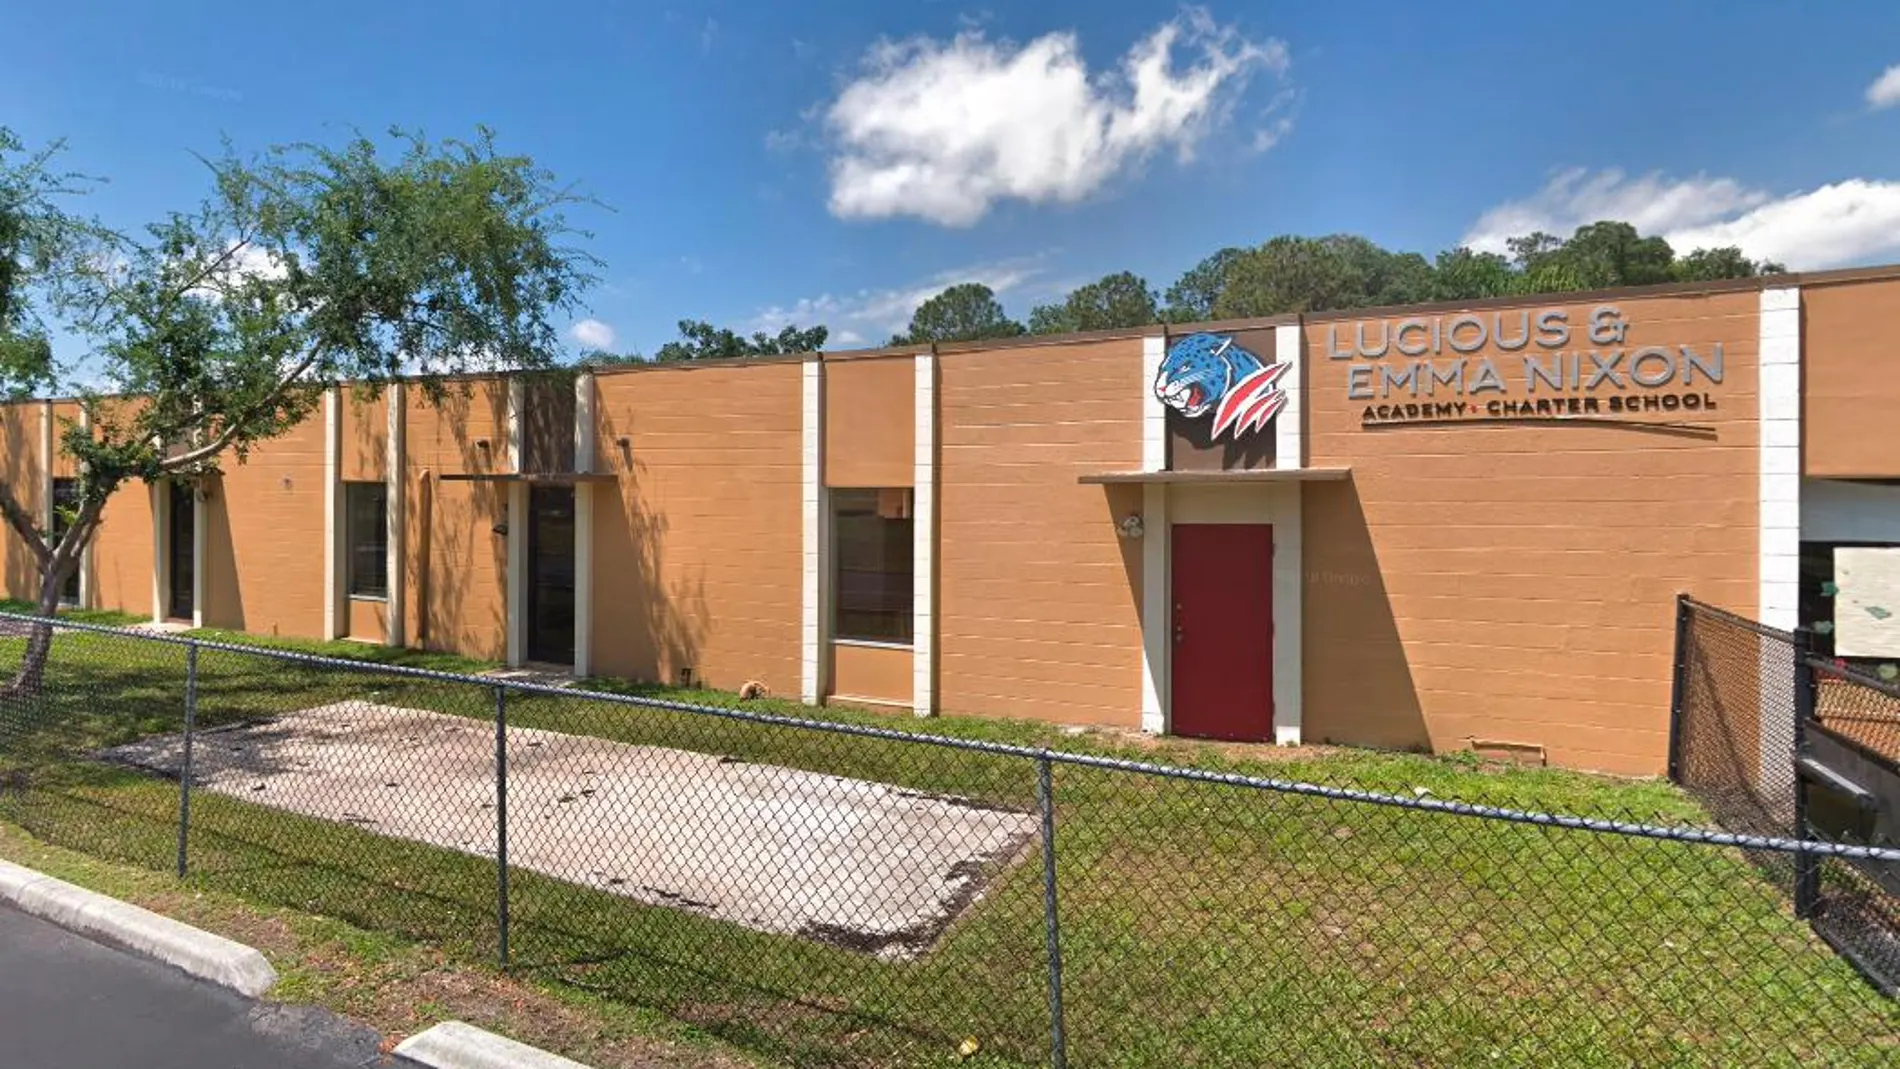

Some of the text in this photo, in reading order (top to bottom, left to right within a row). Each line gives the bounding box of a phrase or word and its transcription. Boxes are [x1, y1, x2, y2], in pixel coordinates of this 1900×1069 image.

[1328, 305, 1629, 359] LUCIOUS &
[1348, 341, 1724, 399] EMMA NIXON
[1362, 393, 1716, 420] ACADEMY CHARTER SCHOOL
